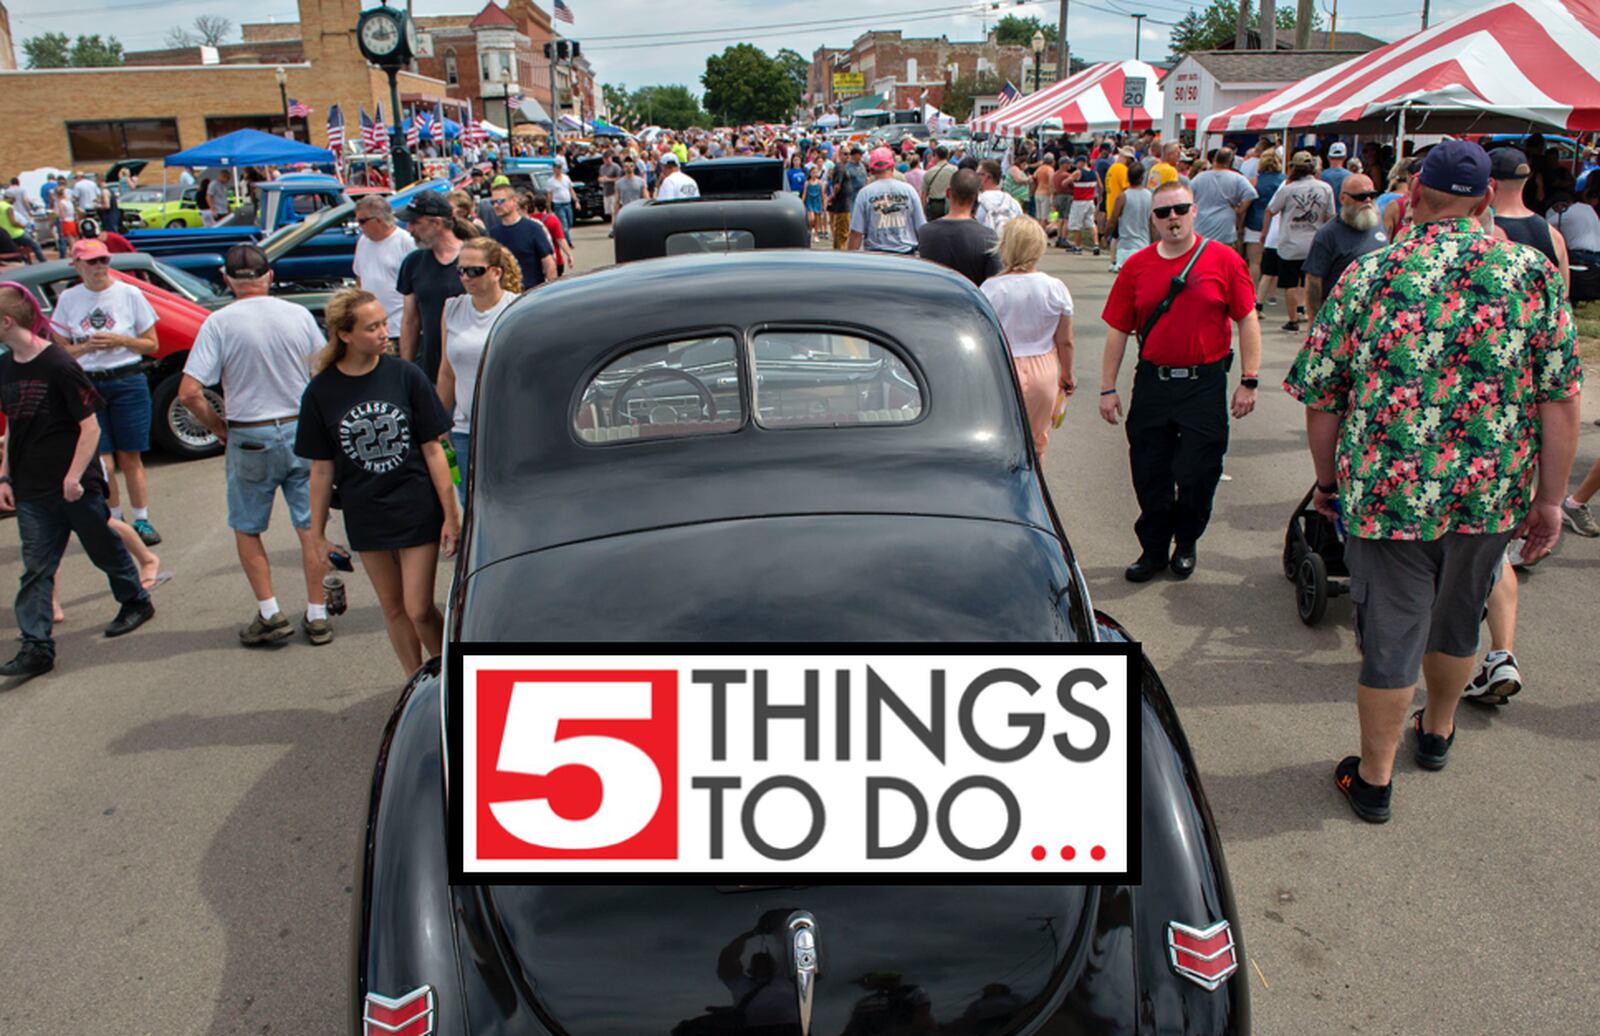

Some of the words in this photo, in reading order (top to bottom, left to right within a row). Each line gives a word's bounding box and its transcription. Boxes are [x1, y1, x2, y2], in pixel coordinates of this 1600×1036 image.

[1124, 92, 1143, 105] 20
[350, 403, 388, 419] CLASS
[350, 414, 402, 461] 22
